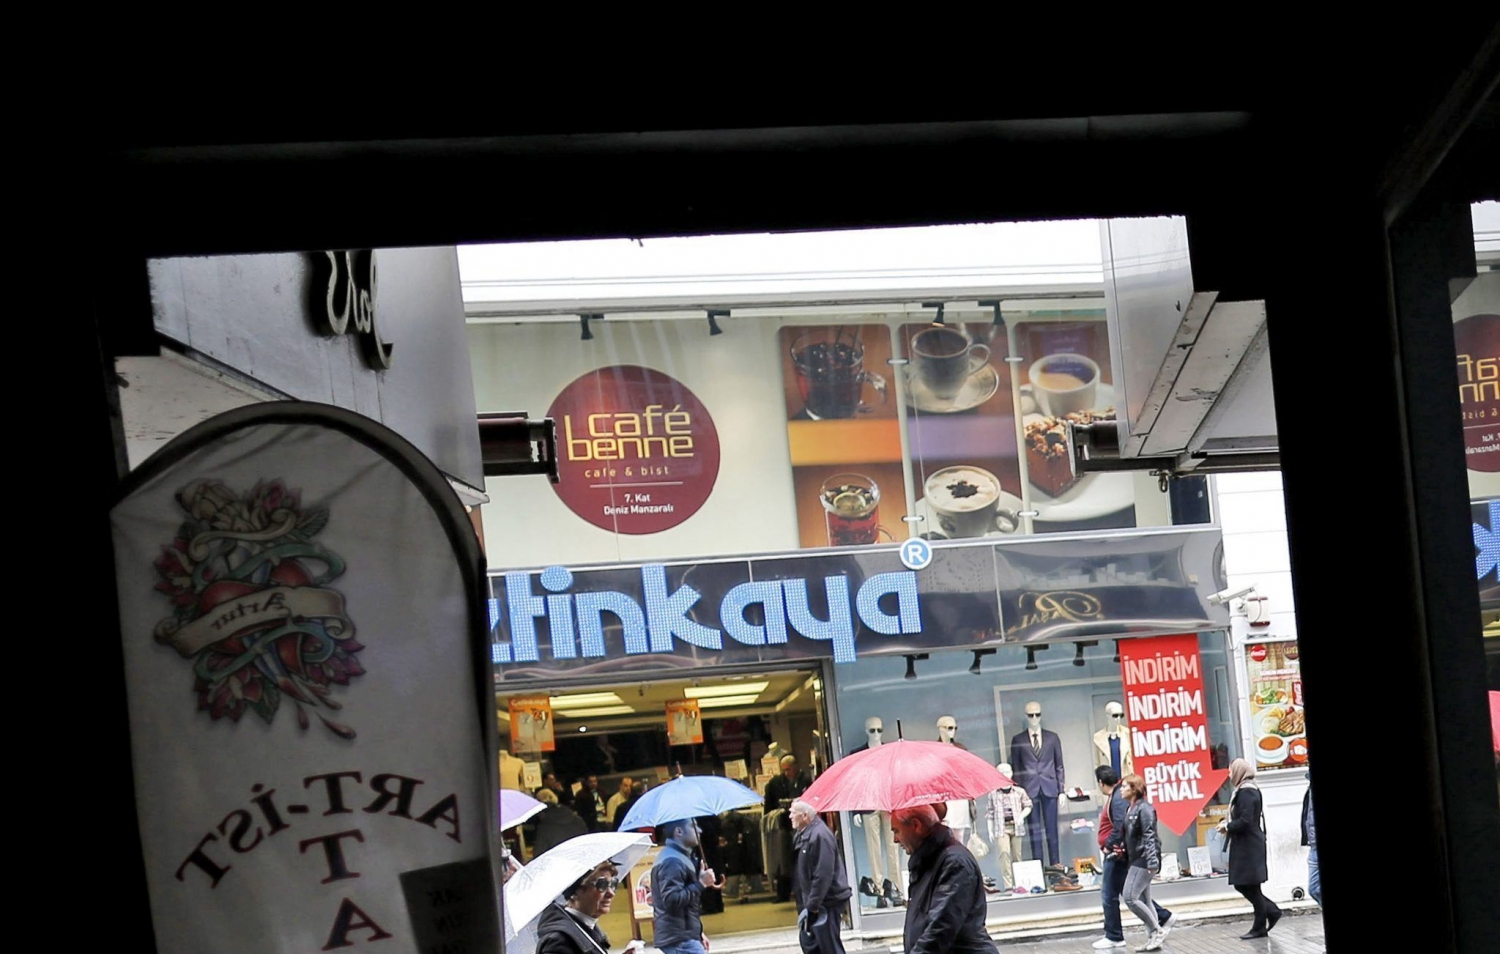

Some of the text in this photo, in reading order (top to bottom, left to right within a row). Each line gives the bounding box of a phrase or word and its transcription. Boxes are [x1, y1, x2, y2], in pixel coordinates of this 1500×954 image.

[587, 404, 692, 437] café
[564, 415, 694, 461] benne
[604, 503, 674, 515] Deniz Manzaralı
[635, 493, 651, 503] Kat
[1123, 651, 1199, 686] İNDİRİM
[1127, 686, 1203, 722] İNDİRİM
[1131, 721, 1207, 758] İNDİRİM
[1143, 760, 1202, 784] BÜYÜK
